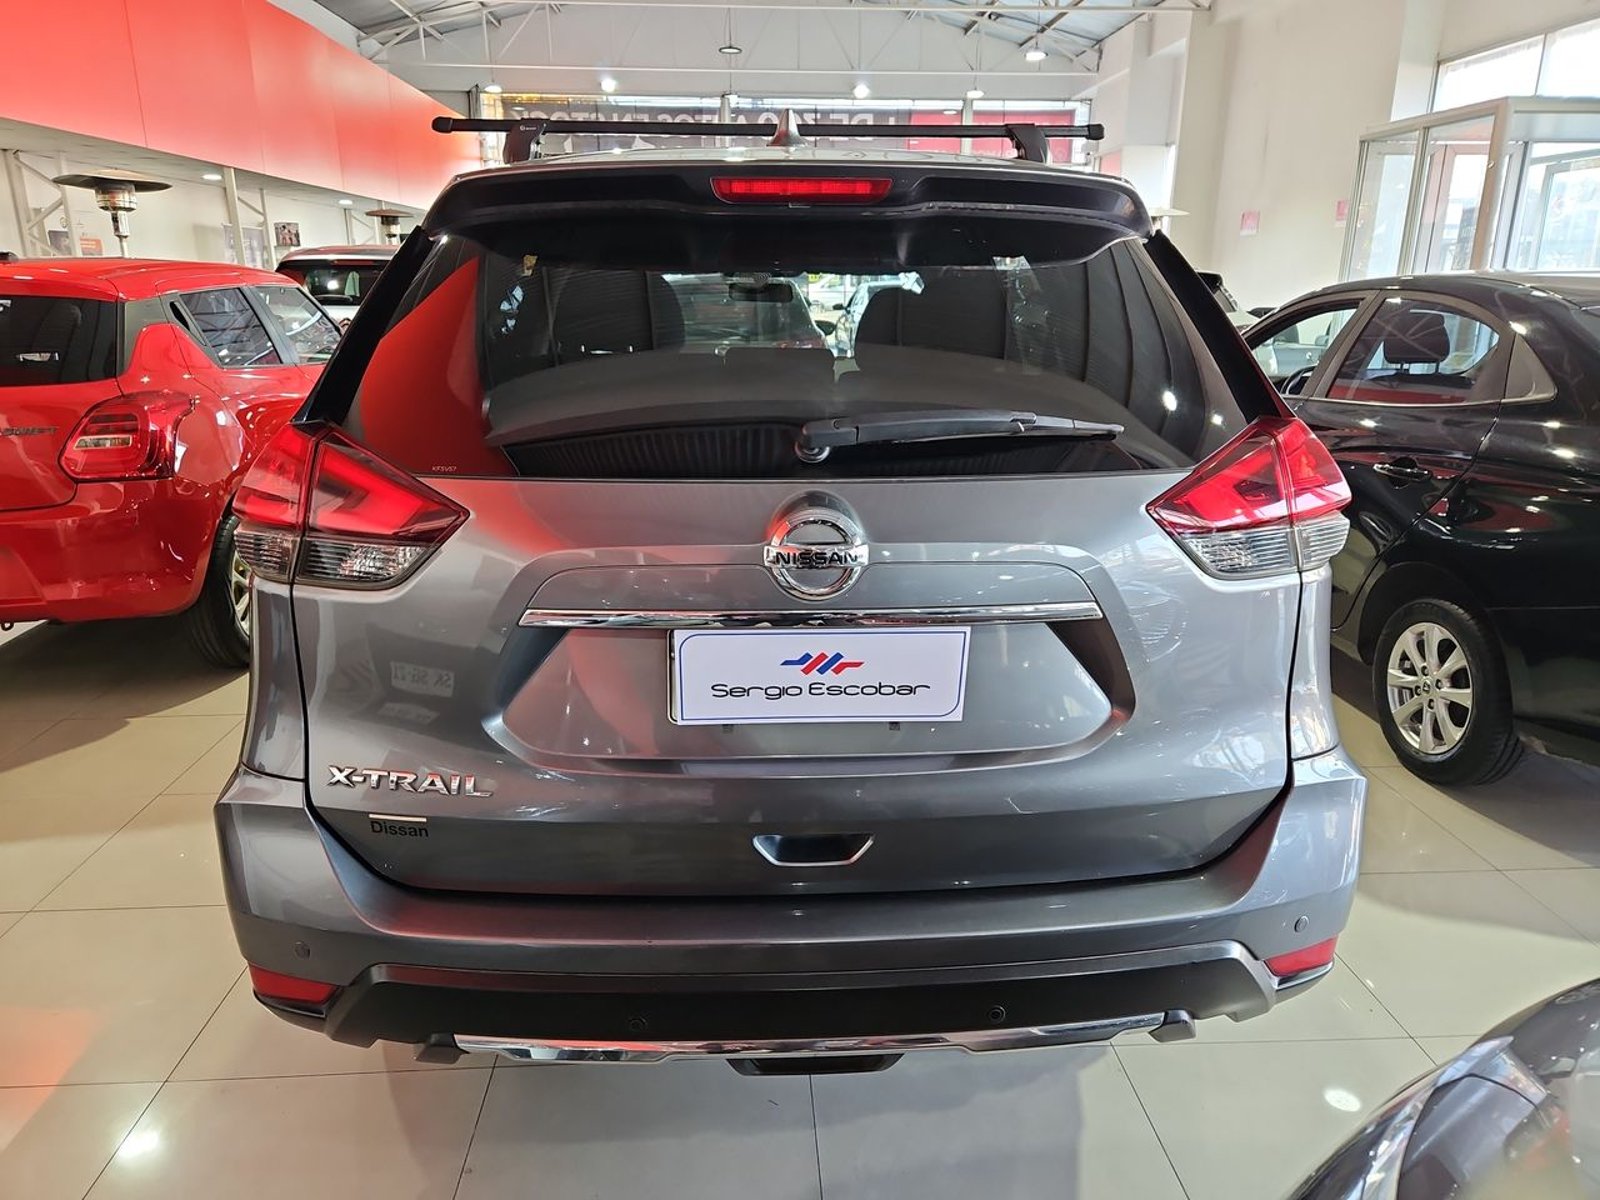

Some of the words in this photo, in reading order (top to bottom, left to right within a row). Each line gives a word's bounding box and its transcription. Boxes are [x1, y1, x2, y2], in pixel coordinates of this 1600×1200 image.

[775, 551, 859, 566] NISSAN
[710, 683, 803, 701] Sergio
[808, 681, 931, 697] Escobar
[327, 765, 493, 797] X-TRAIL
[370, 820, 430, 838] Dissan
